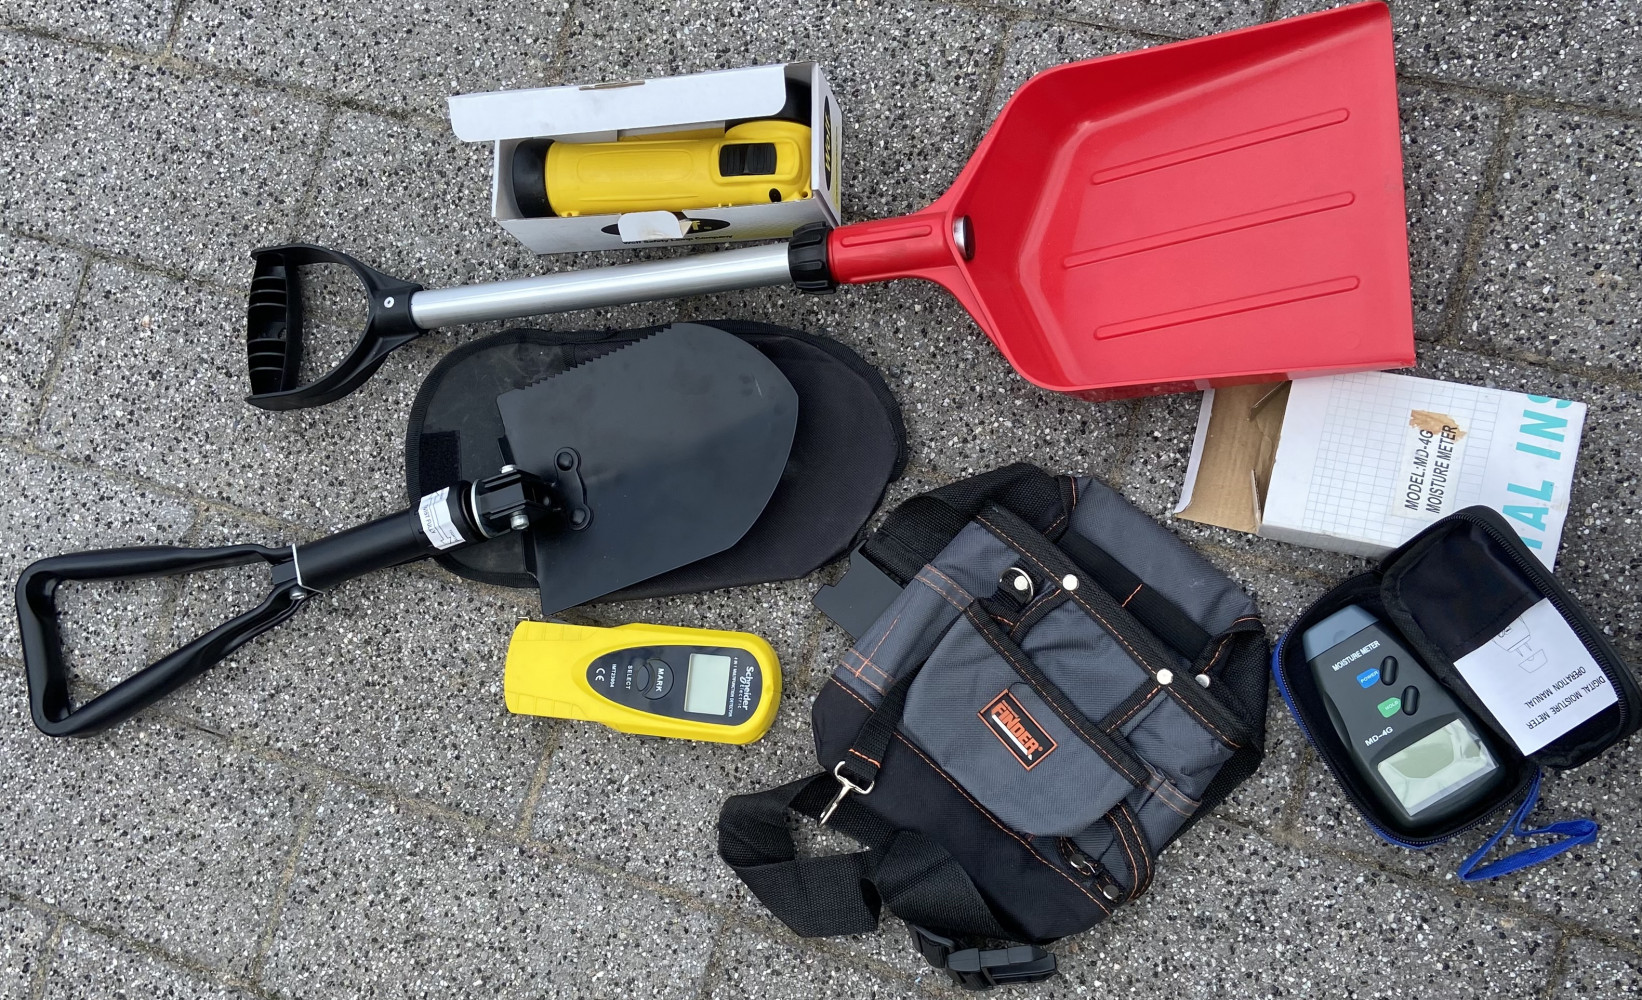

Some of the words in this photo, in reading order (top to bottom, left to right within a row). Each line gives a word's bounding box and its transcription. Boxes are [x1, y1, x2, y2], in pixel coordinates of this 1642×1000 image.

[1404, 429, 1434, 511] MODEL:MD-4G
[1425, 460, 1449, 514] MOISTURE
[1441, 424, 1458, 461] METER
[1331, 650, 1362, 672] MOISTURE
[1360, 640, 1381, 655] METER
[625, 664, 634, 690] SELECT
[655, 667, 665, 692] MARK
[742, 666, 755, 711] Schneider
[1360, 670, 1379, 684] POWER
[1552, 666, 1587, 692] OPERATION
[1581, 675, 1607, 694] DIGITAL
[1384, 700, 1399, 711] HOLD
[1524, 687, 1554, 709] MANUAL
[1549, 690, 1583, 715] MOISTURE
[1526, 711, 1551, 730] METER
[1364, 726, 1394, 747] MD-4G
